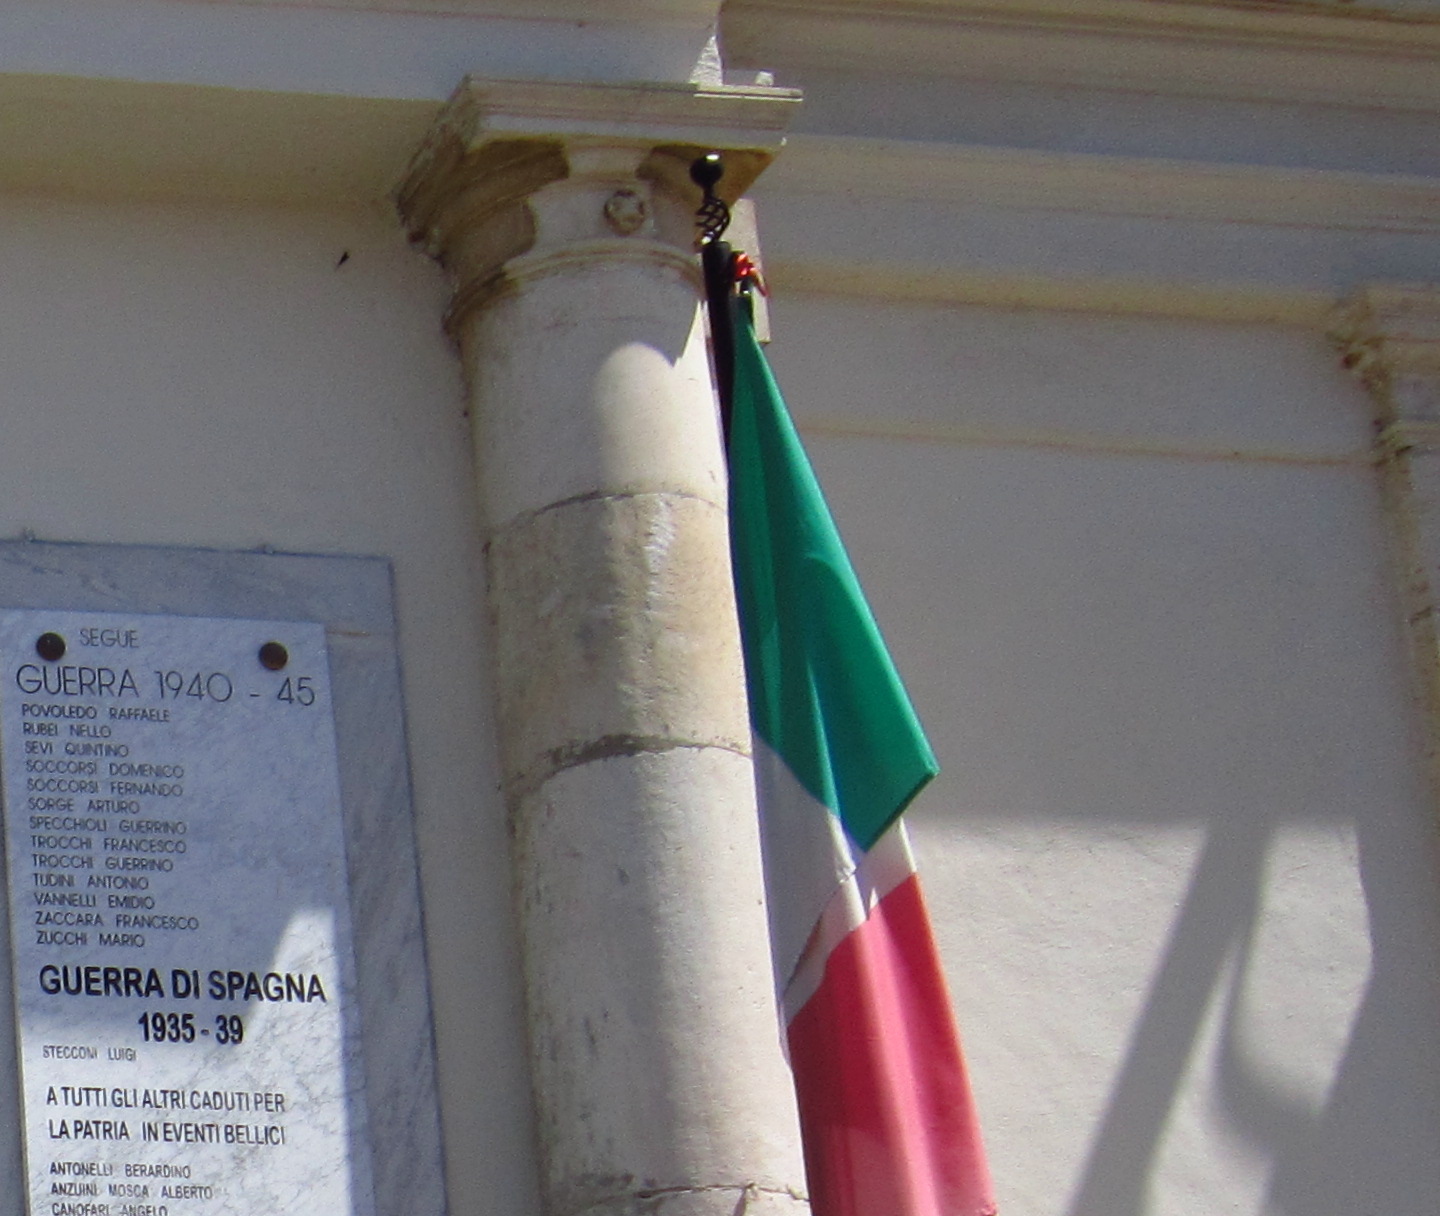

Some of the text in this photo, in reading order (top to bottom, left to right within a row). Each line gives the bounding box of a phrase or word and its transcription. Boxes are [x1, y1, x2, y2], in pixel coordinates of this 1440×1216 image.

[80, 629, 138, 648] SEGUE
[16, 664, 139, 697] GUERRA
[156, 670, 232, 703] 1940
[277, 676, 315, 706] 45
[21, 704, 169, 722] POVOLEDO RAFFAELE
[22, 723, 111, 738] RUBEI NELLO
[26, 760, 184, 778] SOCCORSI DOMENICO
[33, 854, 173, 872] TROCCHI GUERRINO
[36, 932, 144, 948] ZUCCHI MARIO
[40, 965, 326, 1002] GUERRA DI SPAGNA
[139, 1013, 195, 1042] 1935
[216, 1015, 243, 1044] 39
[43, 1046, 136, 1061] STECCONI LUIGI
[47, 1087, 285, 1112] A TUTTI GLI ALTRI CADUTI PER
[49, 1120, 284, 1145] LA PATRIA IN EVENTI BELLICI
